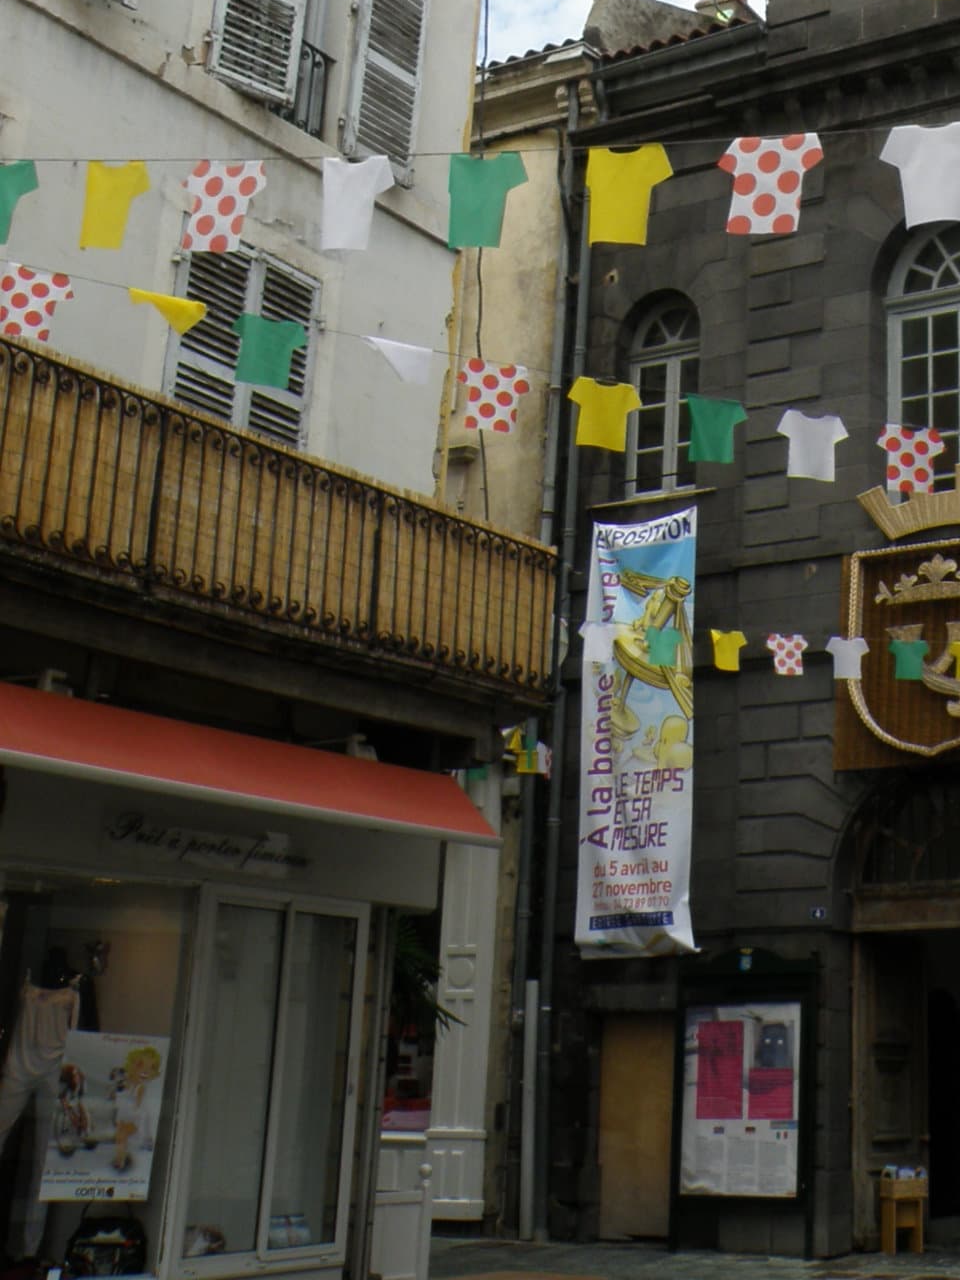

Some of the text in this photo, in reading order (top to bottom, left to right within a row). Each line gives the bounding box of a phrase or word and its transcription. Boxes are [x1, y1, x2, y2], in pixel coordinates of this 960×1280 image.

[596, 516, 691, 549] EXPOSITION
[588, 674, 615, 775] bonne
[615, 767, 685, 798] LE TEMPS
[587, 787, 613, 816] la
[613, 797, 653, 825] ET SA
[611, 822, 668, 851] MESURE
[594, 858, 669, 878] du 5 avril au
[606, 879, 672, 897] novembre
